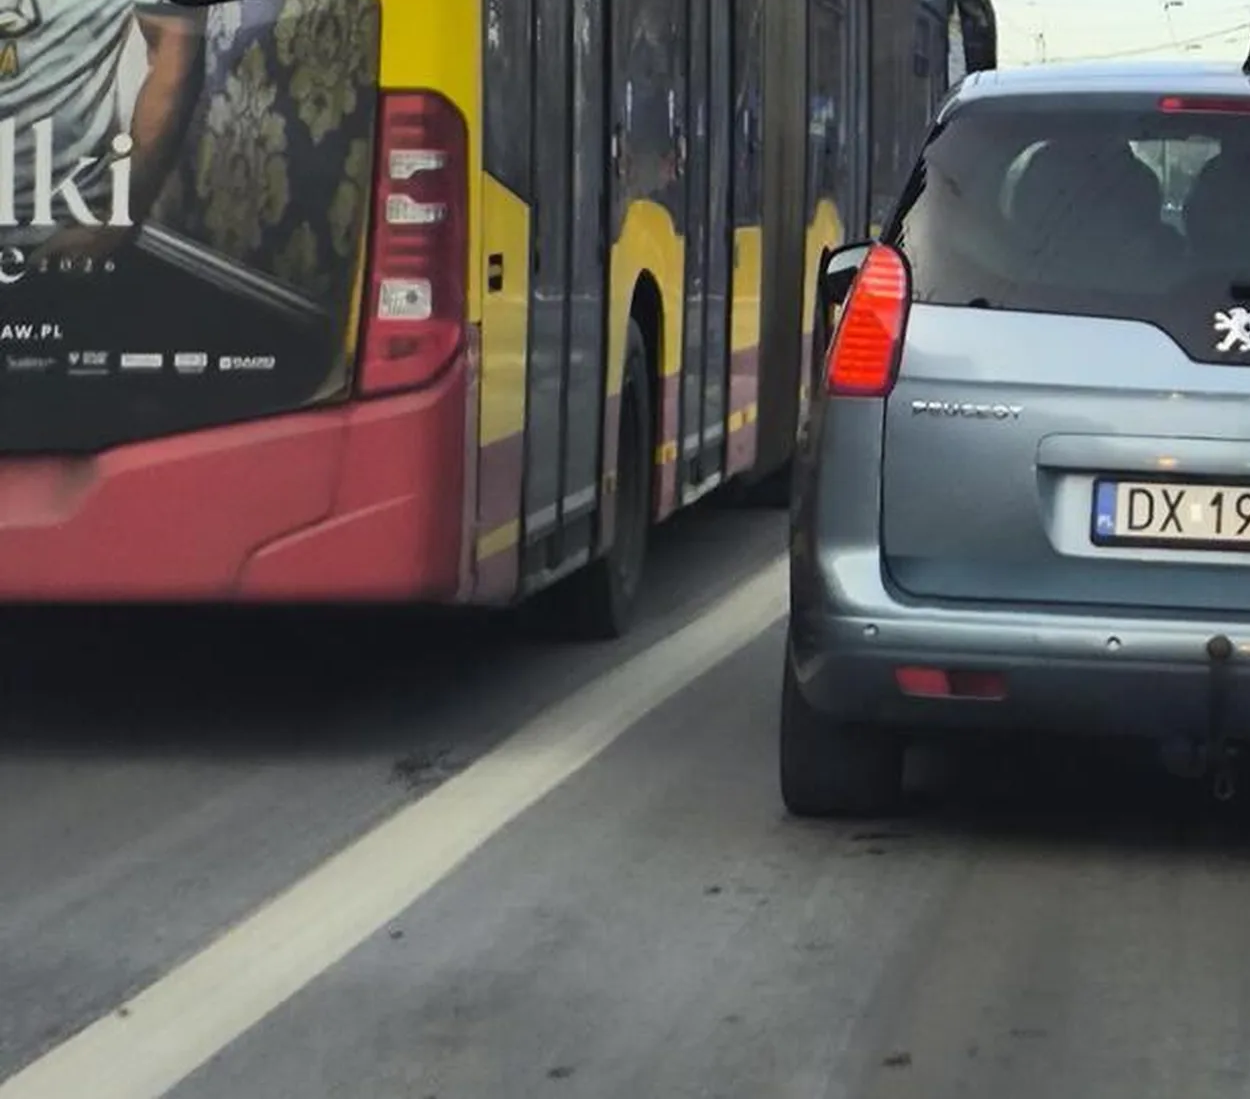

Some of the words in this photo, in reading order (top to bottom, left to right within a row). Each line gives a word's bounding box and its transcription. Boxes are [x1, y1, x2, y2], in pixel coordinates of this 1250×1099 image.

[0, 117, 134, 226] lki
[0, 323, 63, 340] AW.PL
[911, 400, 1025, 421] PEUGEOT
[1126, 487, 1185, 533] DX
